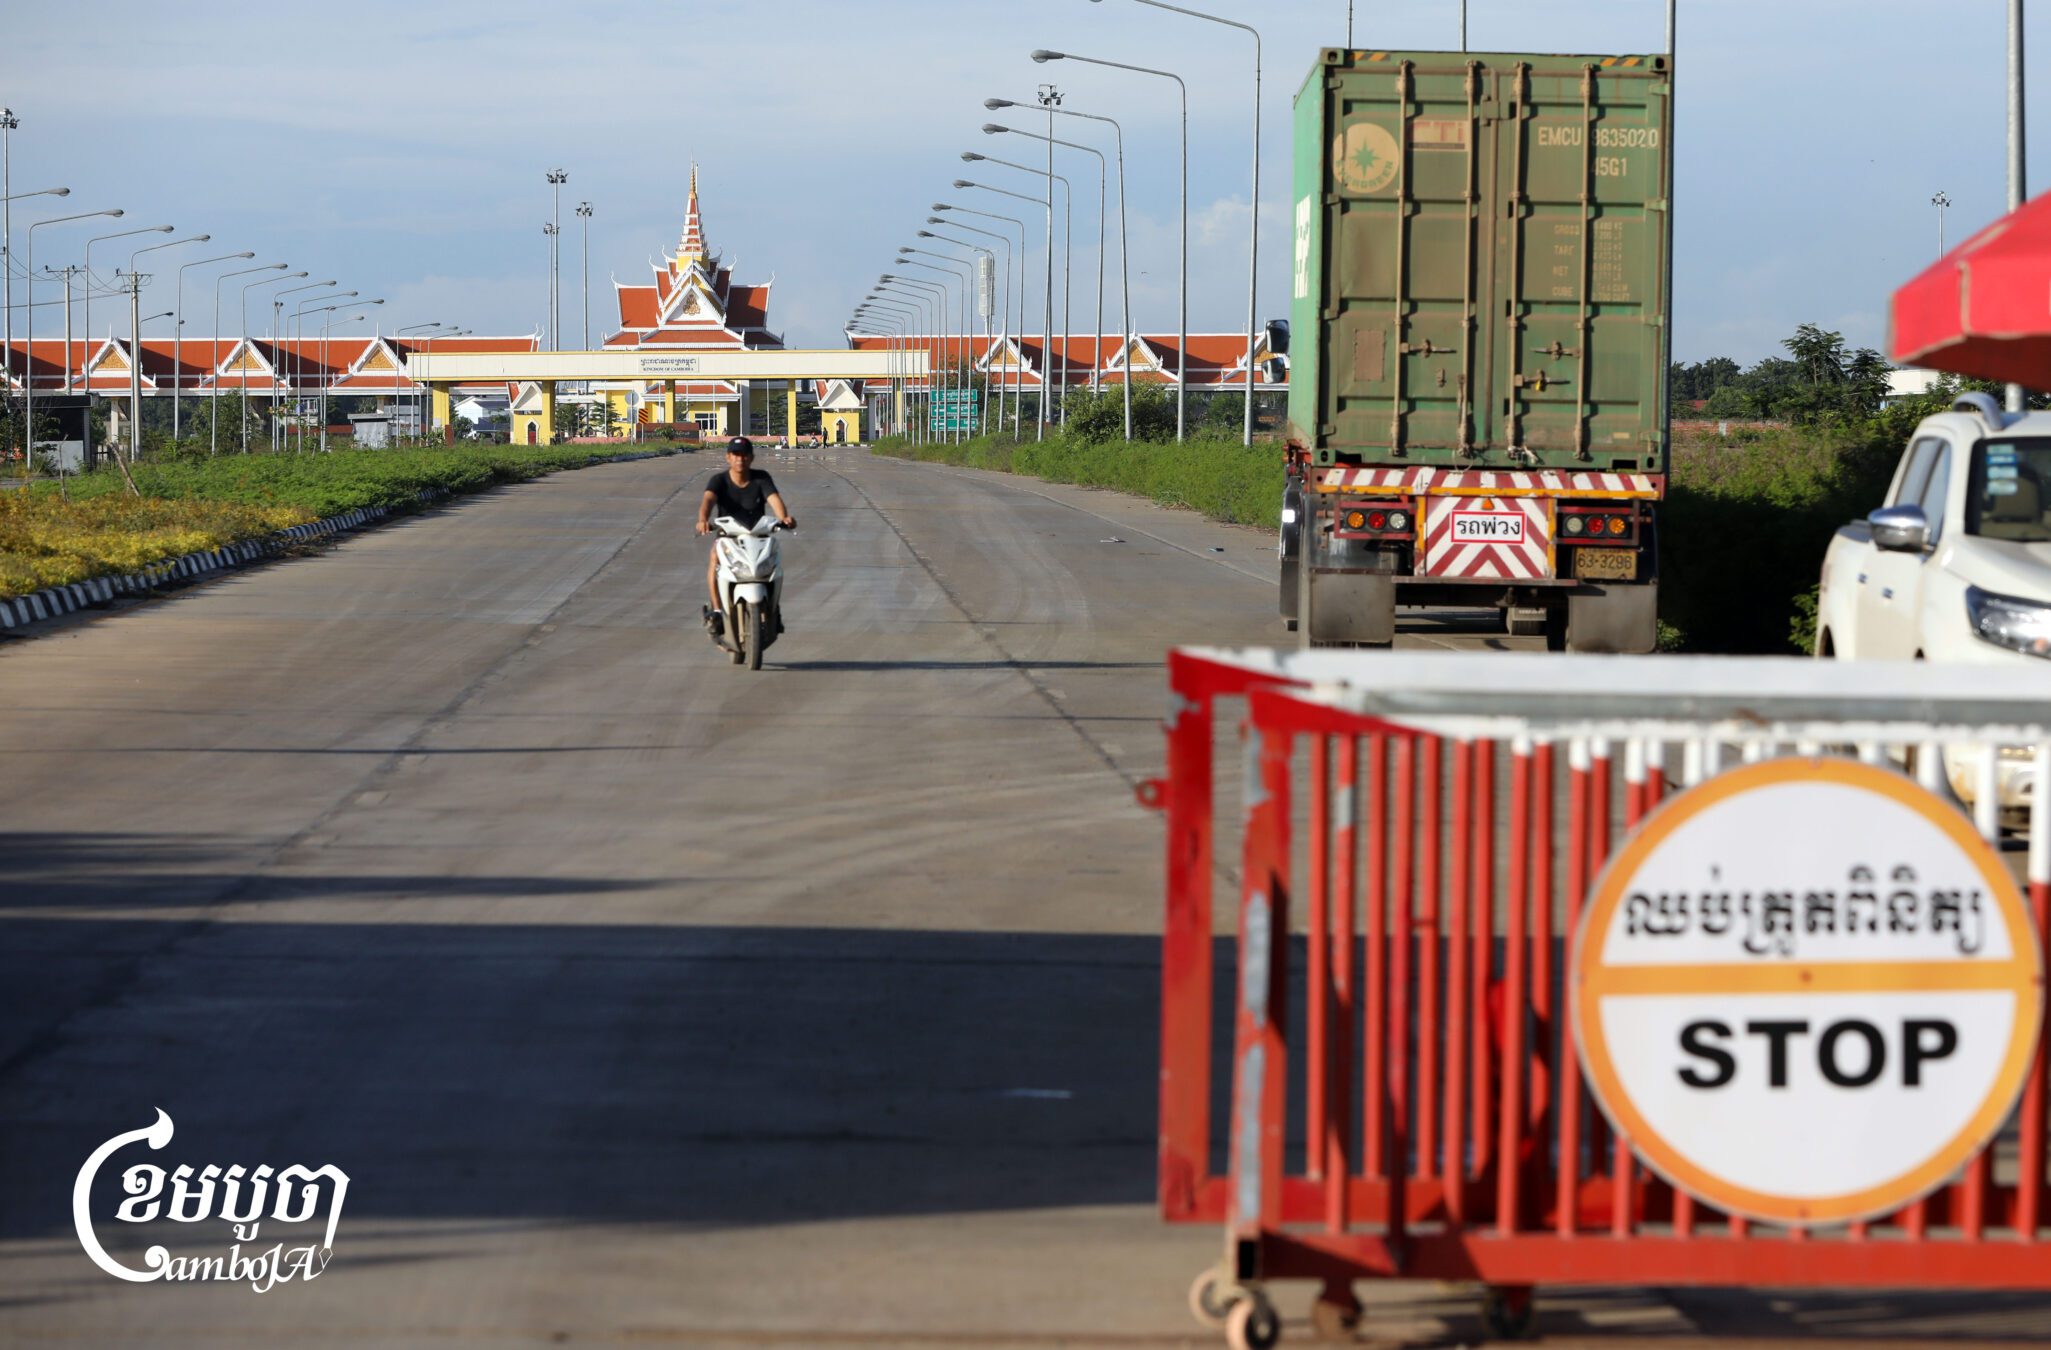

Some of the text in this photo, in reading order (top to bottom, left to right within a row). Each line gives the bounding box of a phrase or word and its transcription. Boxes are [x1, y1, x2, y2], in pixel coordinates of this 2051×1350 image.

[1538, 127, 1581, 146] EMCU
[1456, 516, 1521, 535] รถพ่วง
[1676, 1018, 1959, 1089] STOP
